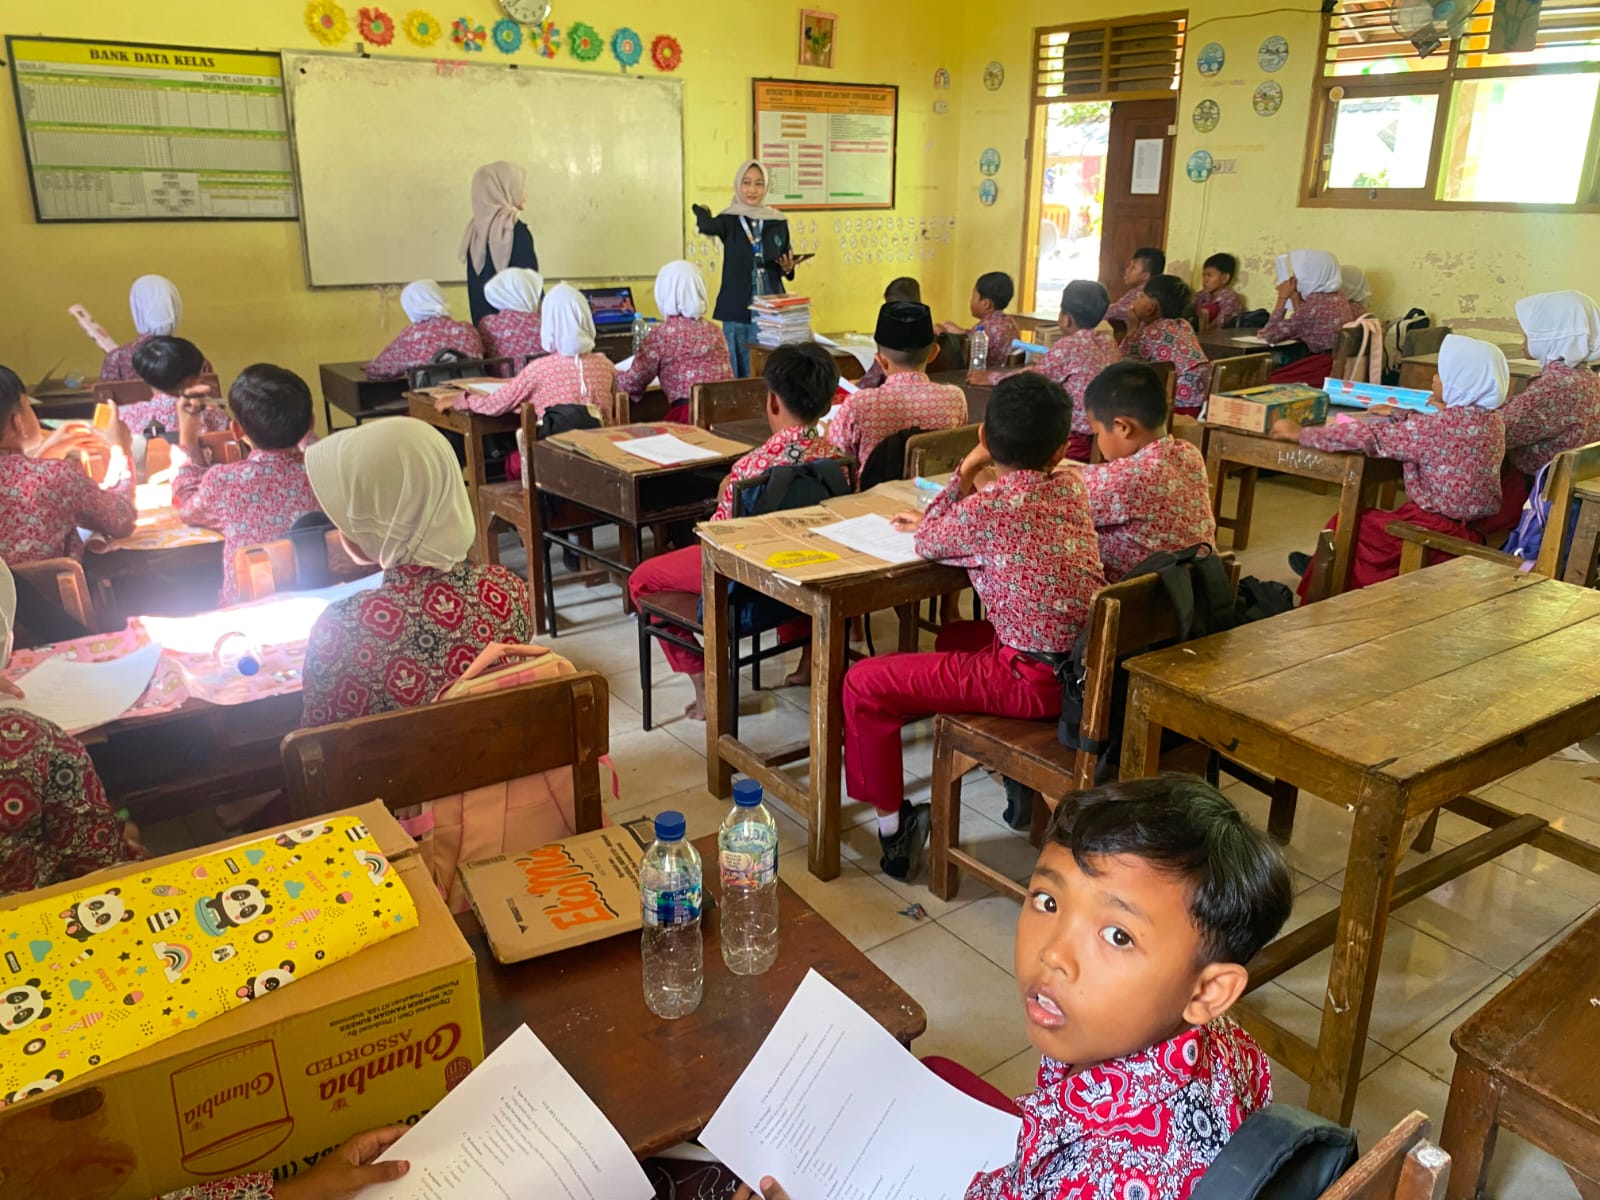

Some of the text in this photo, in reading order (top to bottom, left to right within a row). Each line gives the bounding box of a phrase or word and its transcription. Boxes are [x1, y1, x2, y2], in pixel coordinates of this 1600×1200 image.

[89, 48, 215, 68] BANK DATA KELAS
[305, 1028, 414, 1077] ASSORTED
[319, 1022, 462, 1101] Columbia
[184, 1071, 275, 1125] Columbia
